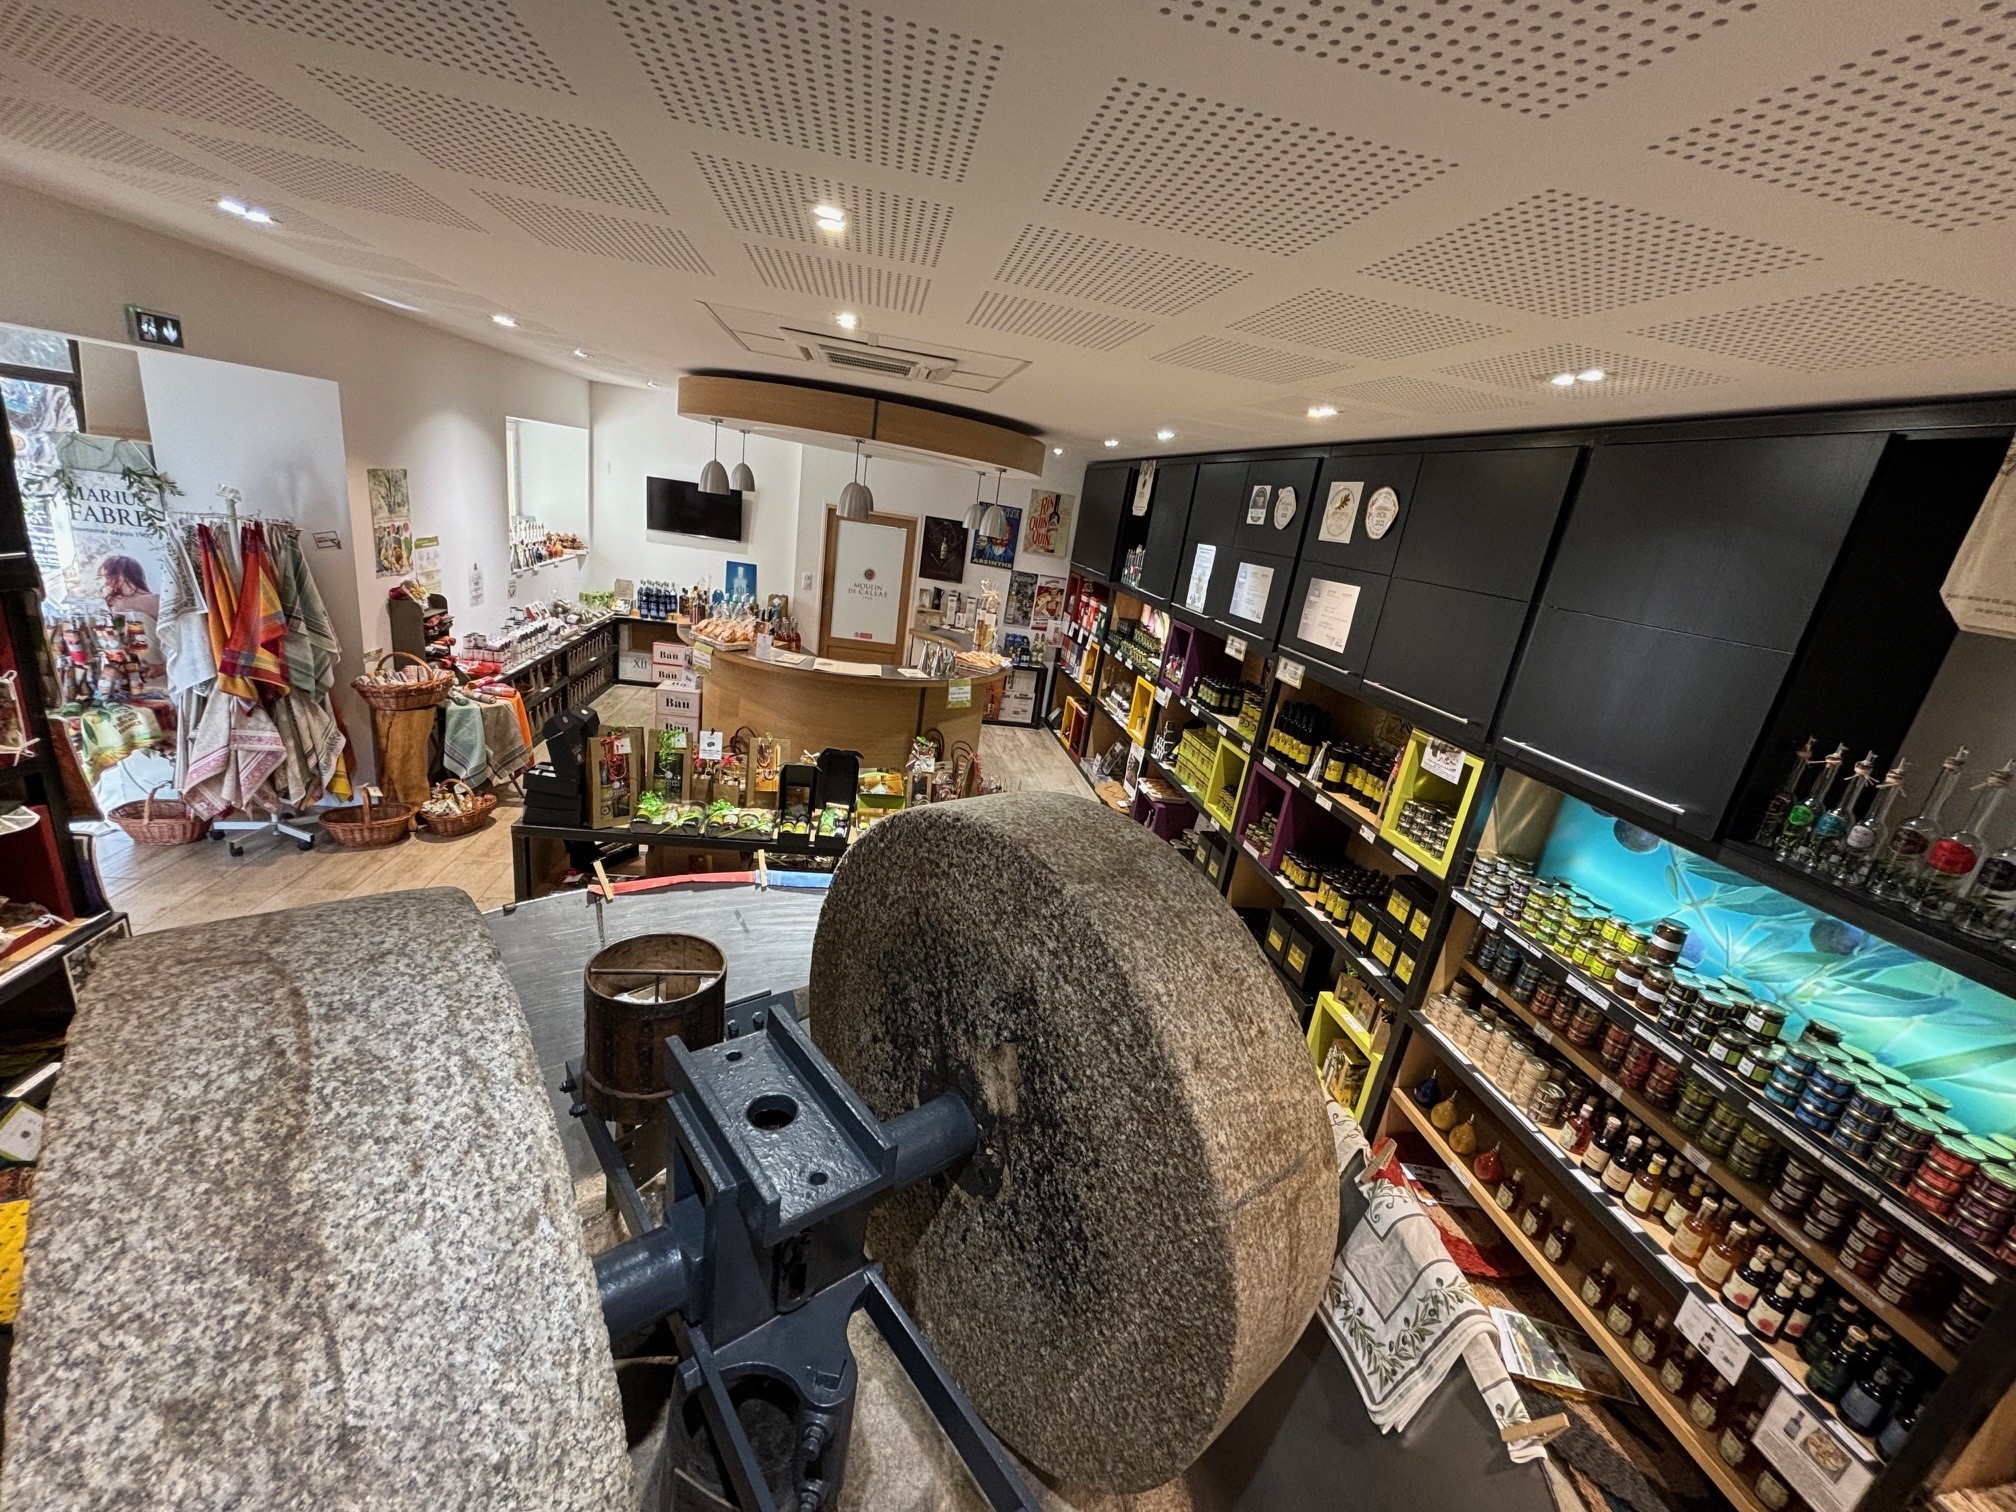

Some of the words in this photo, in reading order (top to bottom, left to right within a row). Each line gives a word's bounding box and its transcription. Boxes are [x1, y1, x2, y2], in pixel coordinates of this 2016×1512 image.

[1029, 515, 1049, 532] QUIN
[1032, 530, 1051, 548] QUIN
[972, 557, 1012, 569] ABSINTHE
[853, 582, 883, 591] MOULIN
[858, 588, 888, 599] CALLAS
[633, 658, 648, 669] XII
[665, 697, 690, 709] Bau
